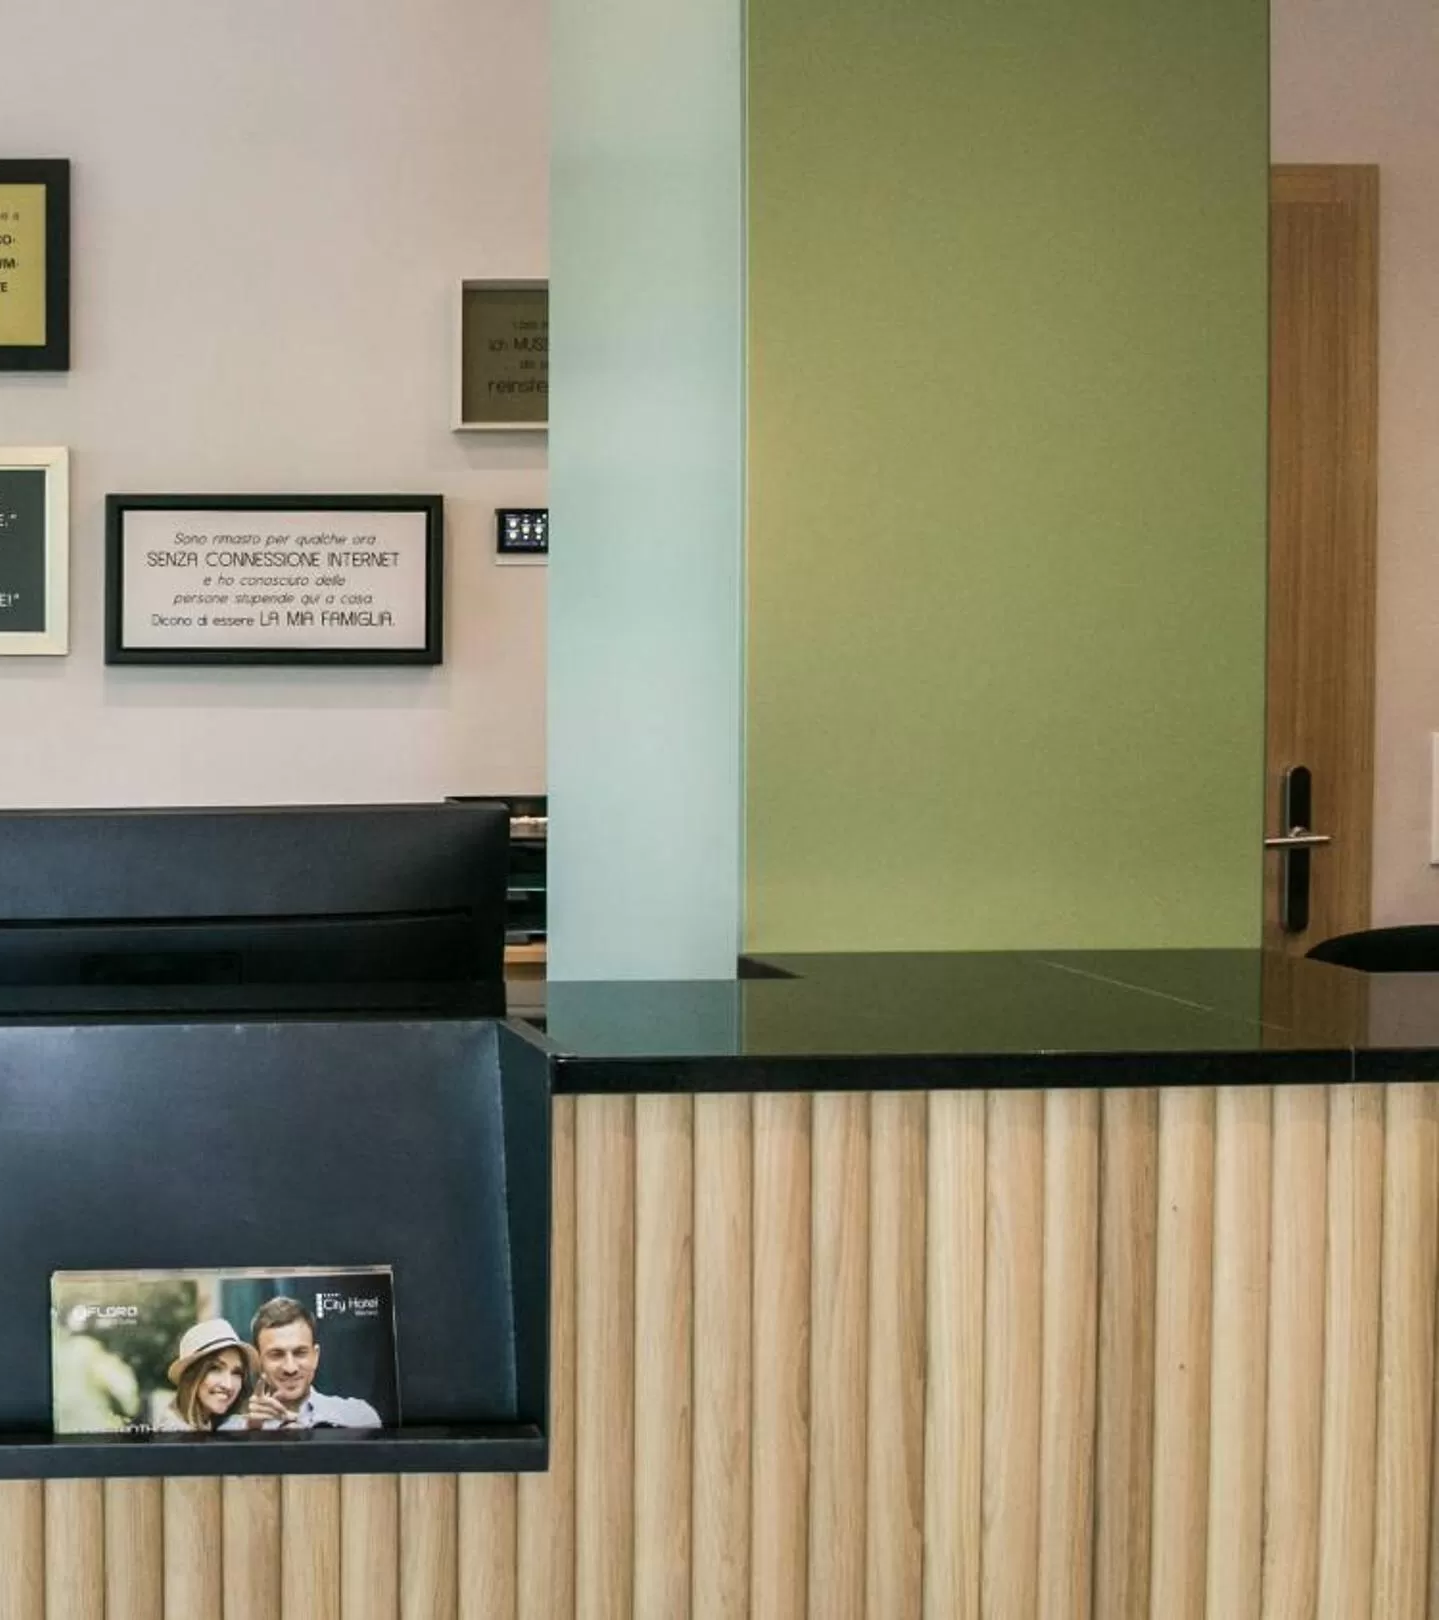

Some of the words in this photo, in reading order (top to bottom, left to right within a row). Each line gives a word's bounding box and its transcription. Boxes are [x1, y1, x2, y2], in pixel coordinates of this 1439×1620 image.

[12, 212, 19, 221] a
[174, 532, 208, 545] Sono
[212, 532, 261, 545] rimasto
[265, 534, 290, 548] per
[294, 532, 347, 548] qualche
[352, 535, 377, 545] ora
[146, 552, 198, 567] SENZA
[206, 552, 321, 567] CONNESSIONE
[327, 552, 401, 567] INTERNET
[202, 577, 211, 586] e
[218, 574, 234, 586] ho
[240, 574, 310, 586] conosciuto
[315, 574, 346, 586] delle
[172, 594, 229, 607] persone
[235, 592, 295, 607] stupende
[300, 592, 321, 606] qui
[325, 595, 334, 605] a
[340, 594, 373, 605] casa
[152, 614, 192, 627] Dicono
[197, 614, 208, 627] di
[213, 616, 255, 627] essere
[260, 611, 280, 627] LA
[287, 611, 314, 627] MIA
[321, 611, 396, 627] FAMIGLIA.
